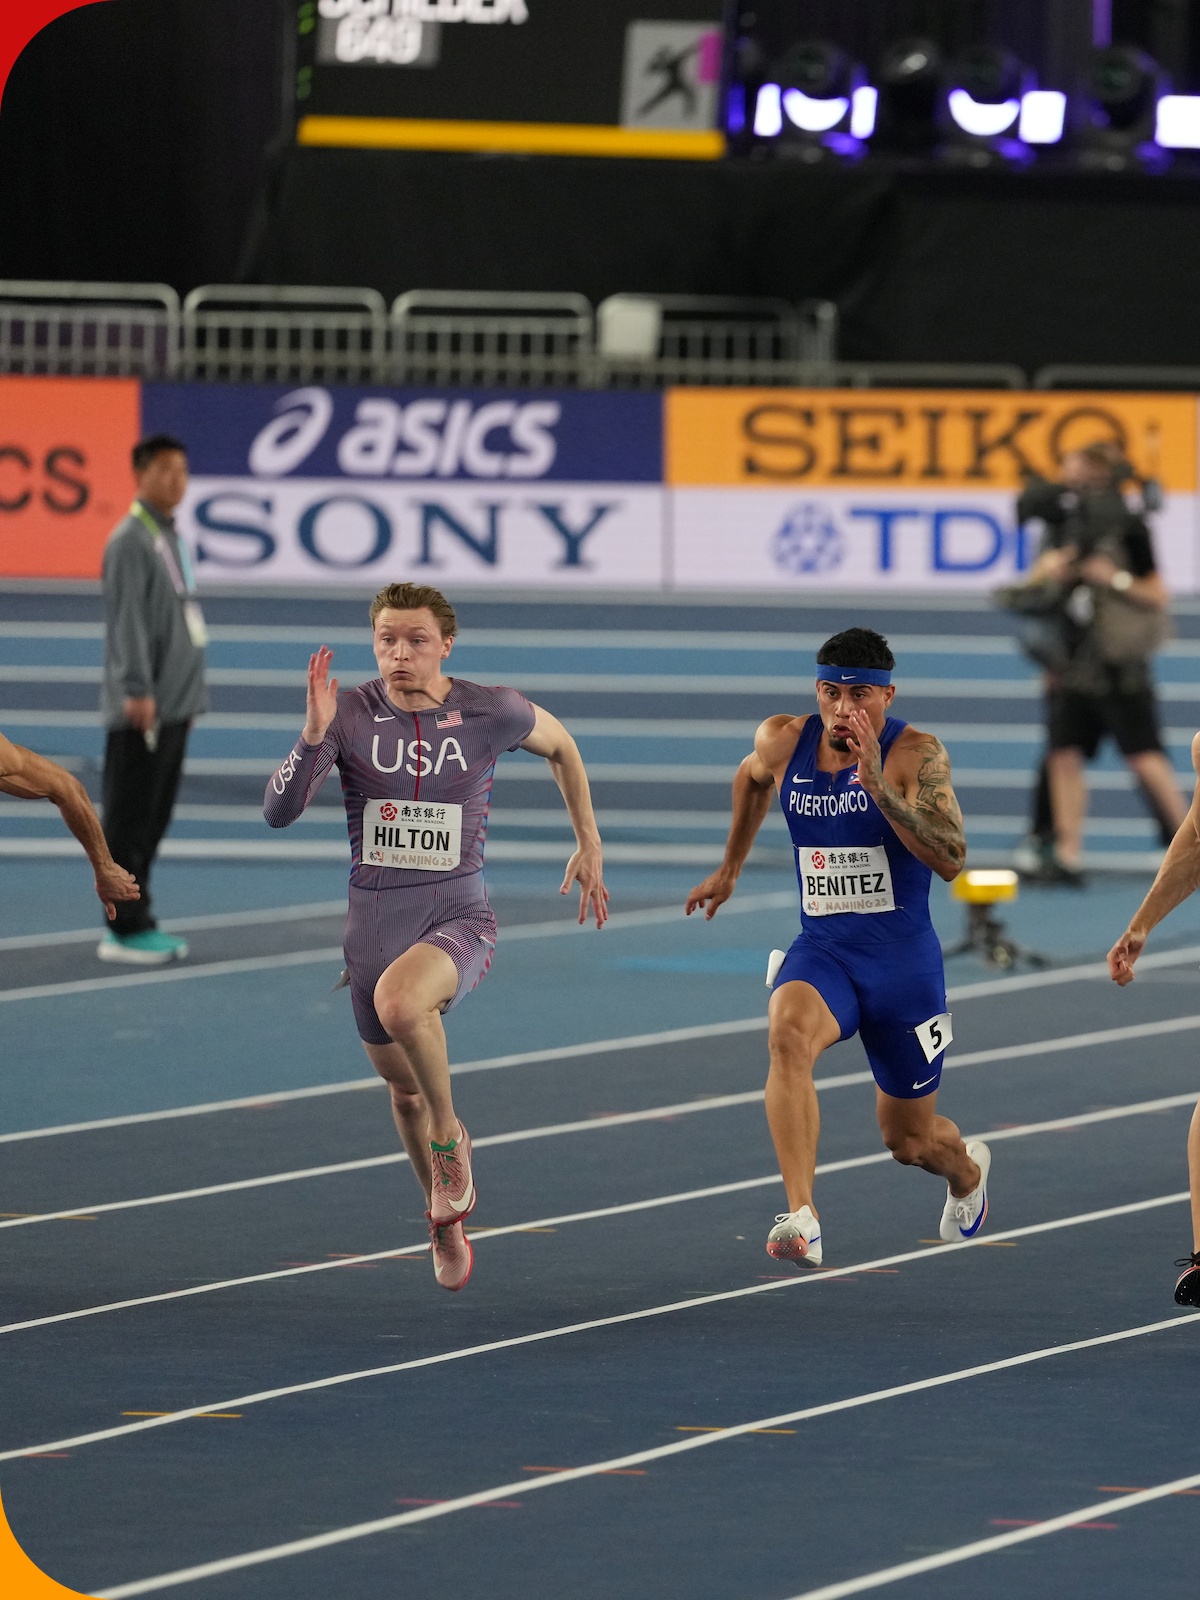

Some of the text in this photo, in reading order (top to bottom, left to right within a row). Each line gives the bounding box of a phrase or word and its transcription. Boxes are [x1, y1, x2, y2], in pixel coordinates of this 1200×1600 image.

[194, 491, 618, 571] SONY
[371, 734, 468, 777] USA
[272, 749, 302, 795] USA
[789, 790, 868, 817] PUERTO RICO
[374, 825, 450, 851] HILTON
[391, 853, 454, 867] NANJING 25
[806, 872, 886, 896] BENITEZ
[825, 898, 888, 913] NANJING 25
[929, 1020, 943, 1050] 5
